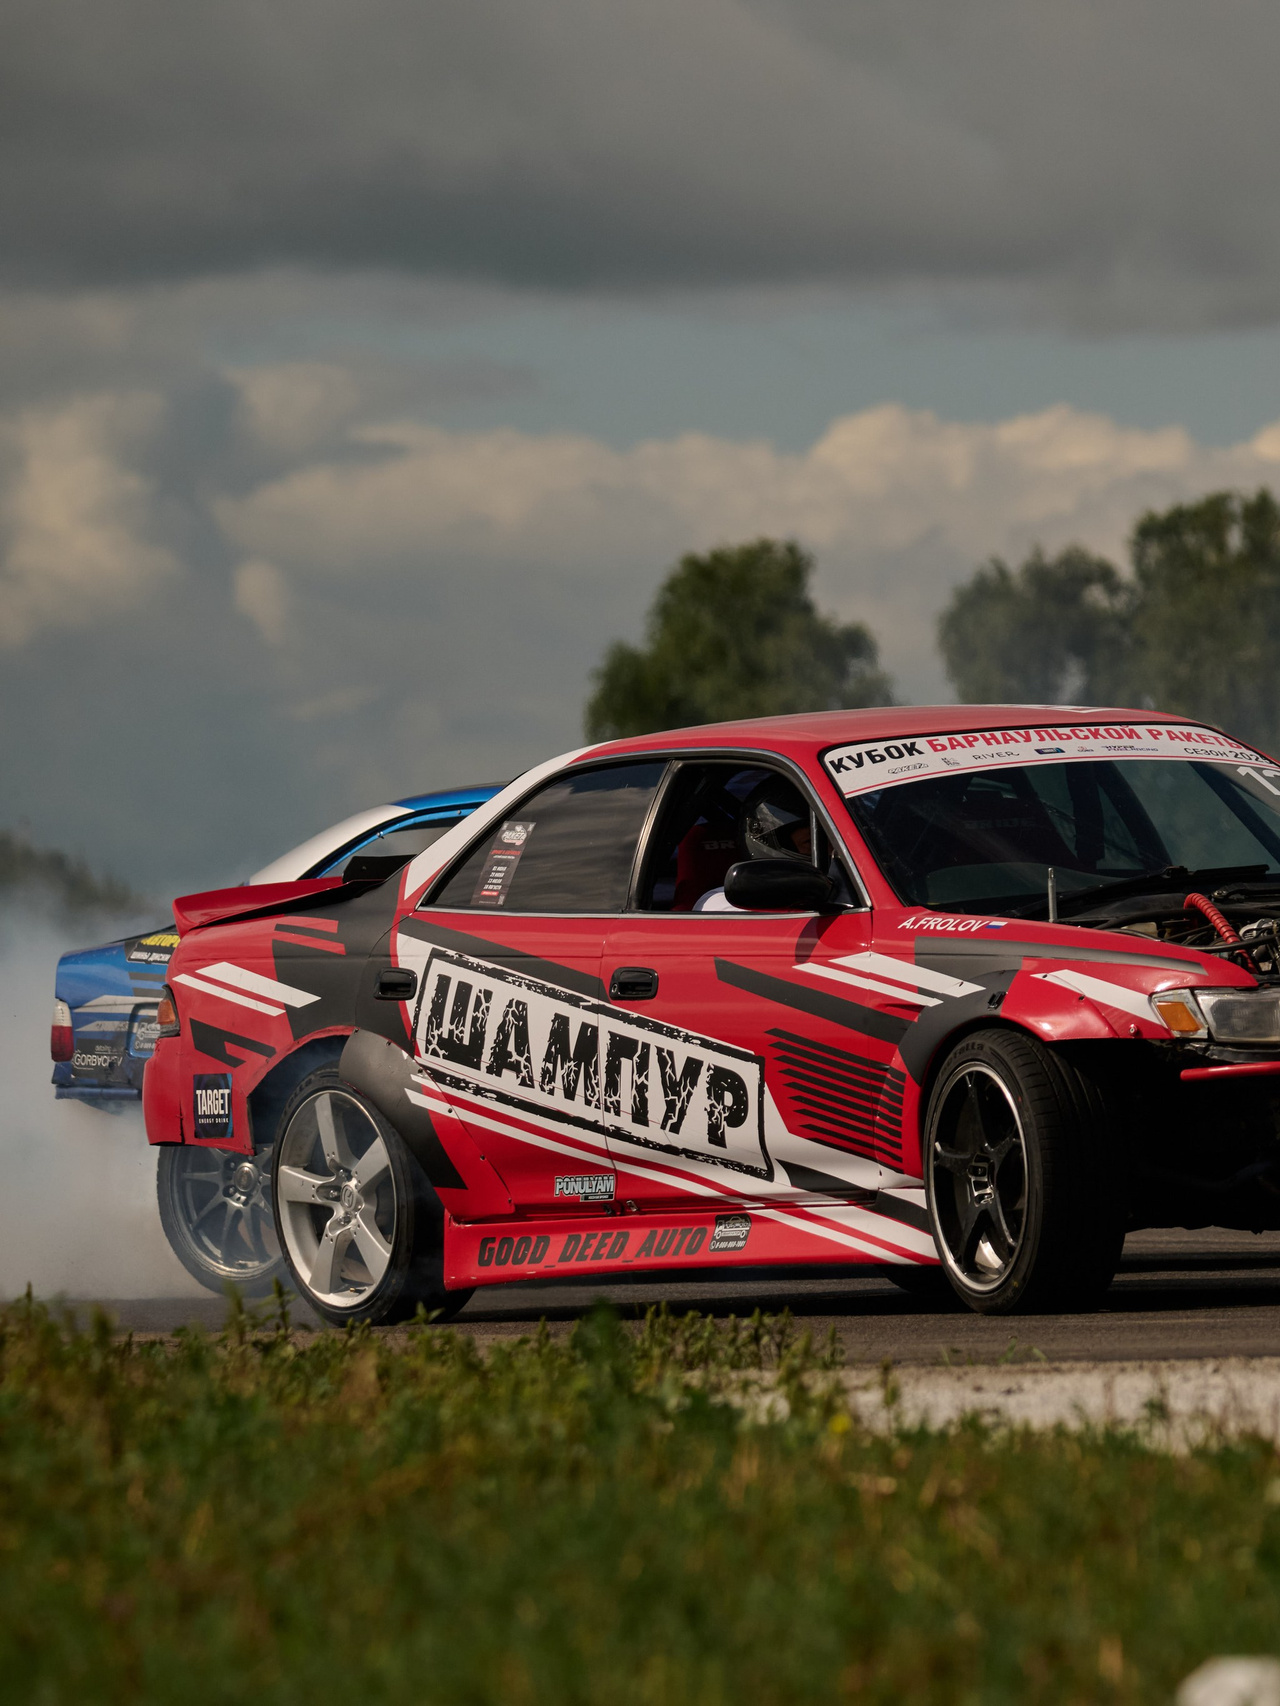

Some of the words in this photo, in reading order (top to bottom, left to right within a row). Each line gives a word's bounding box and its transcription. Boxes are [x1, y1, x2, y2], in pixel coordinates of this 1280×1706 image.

[829, 741, 925, 774] КУБОК
[926, 725, 1142, 753] БАРНАУЛЬСКОЙ
[1146, 728, 1250, 750] РАКЕТЫ
[972, 751, 1020, 760] RIVER
[1184, 747, 1229, 758] СЕЗОН
[898, 917, 990, 932] A.FROLOV
[424, 972, 752, 1149] ШАМПУР
[196, 1089, 230, 1115] TARGET
[555, 1175, 614, 1195] PONULYAM
